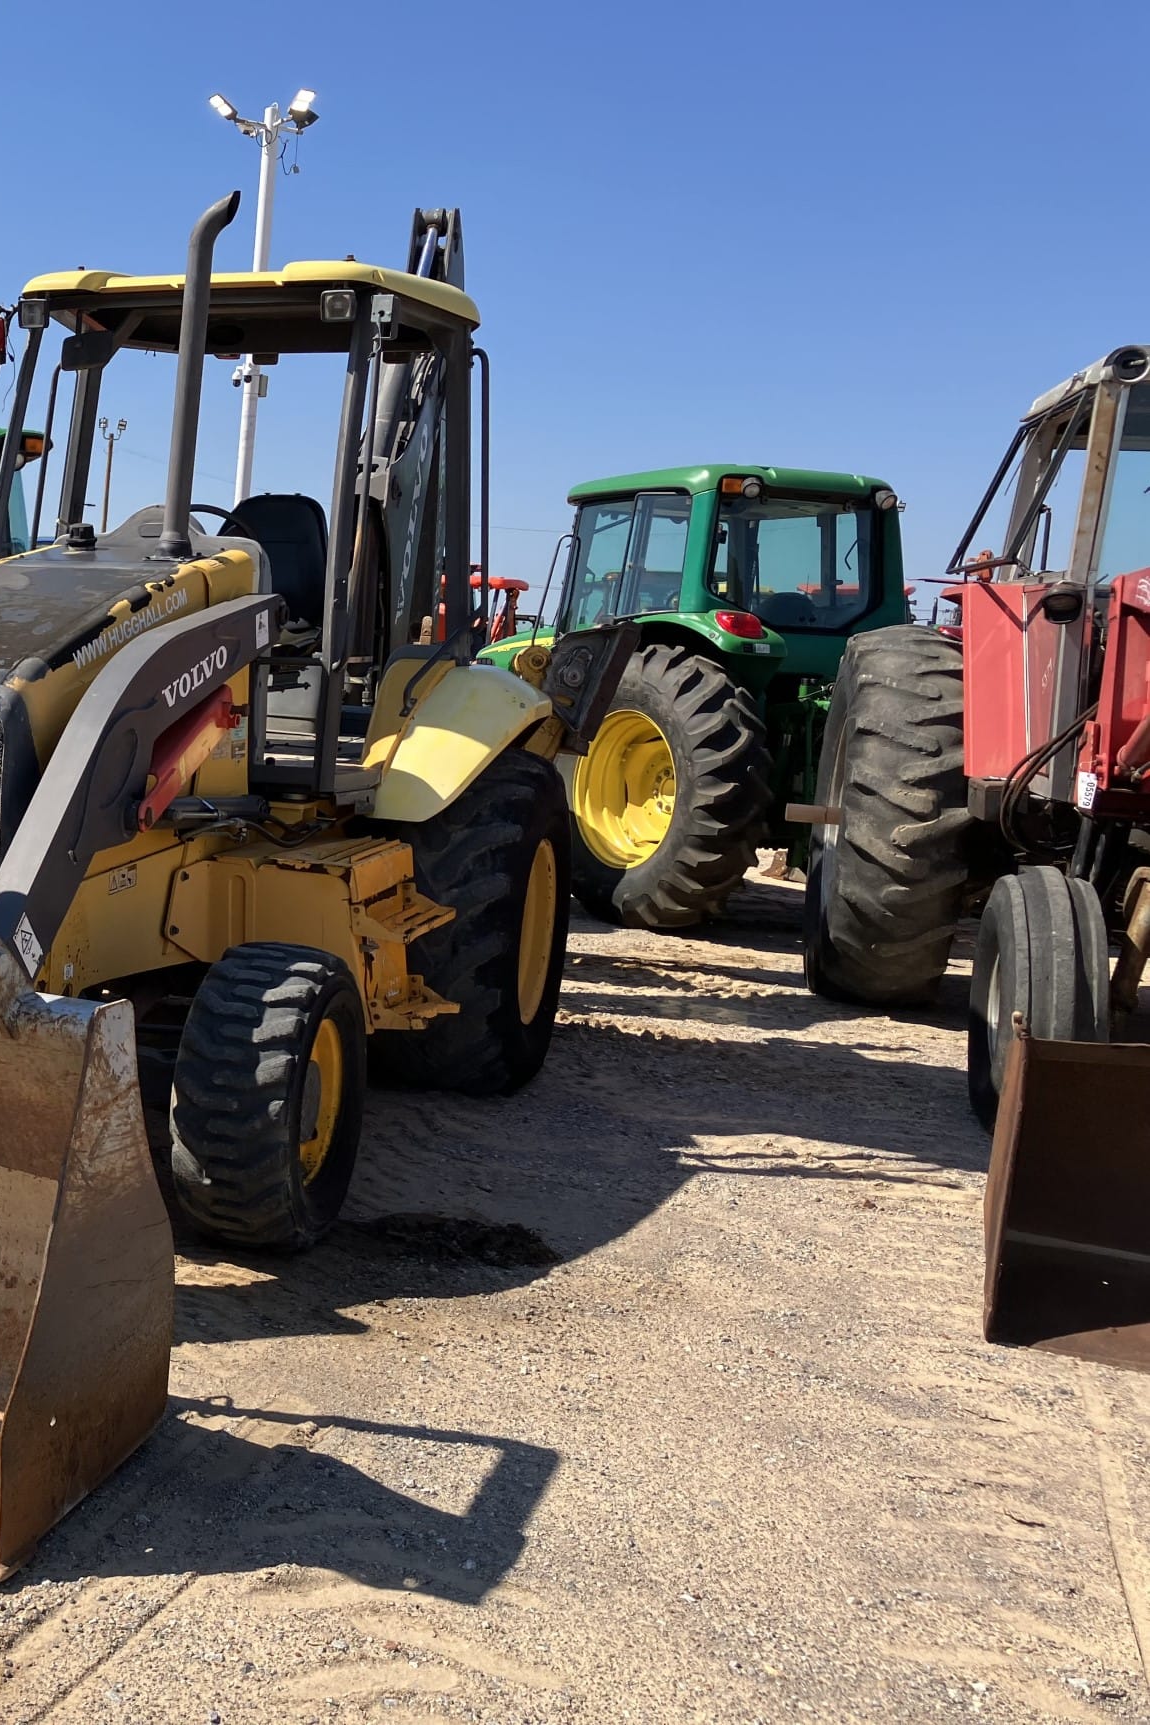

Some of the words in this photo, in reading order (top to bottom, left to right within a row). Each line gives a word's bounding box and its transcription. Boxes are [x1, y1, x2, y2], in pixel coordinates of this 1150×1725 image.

[395, 423, 427, 624] VOLVO
[72, 588, 188, 670] WWW.HUGGHALL.COM
[162, 645, 228, 708] VOLVO
[1082, 782, 1096, 807] 05579
